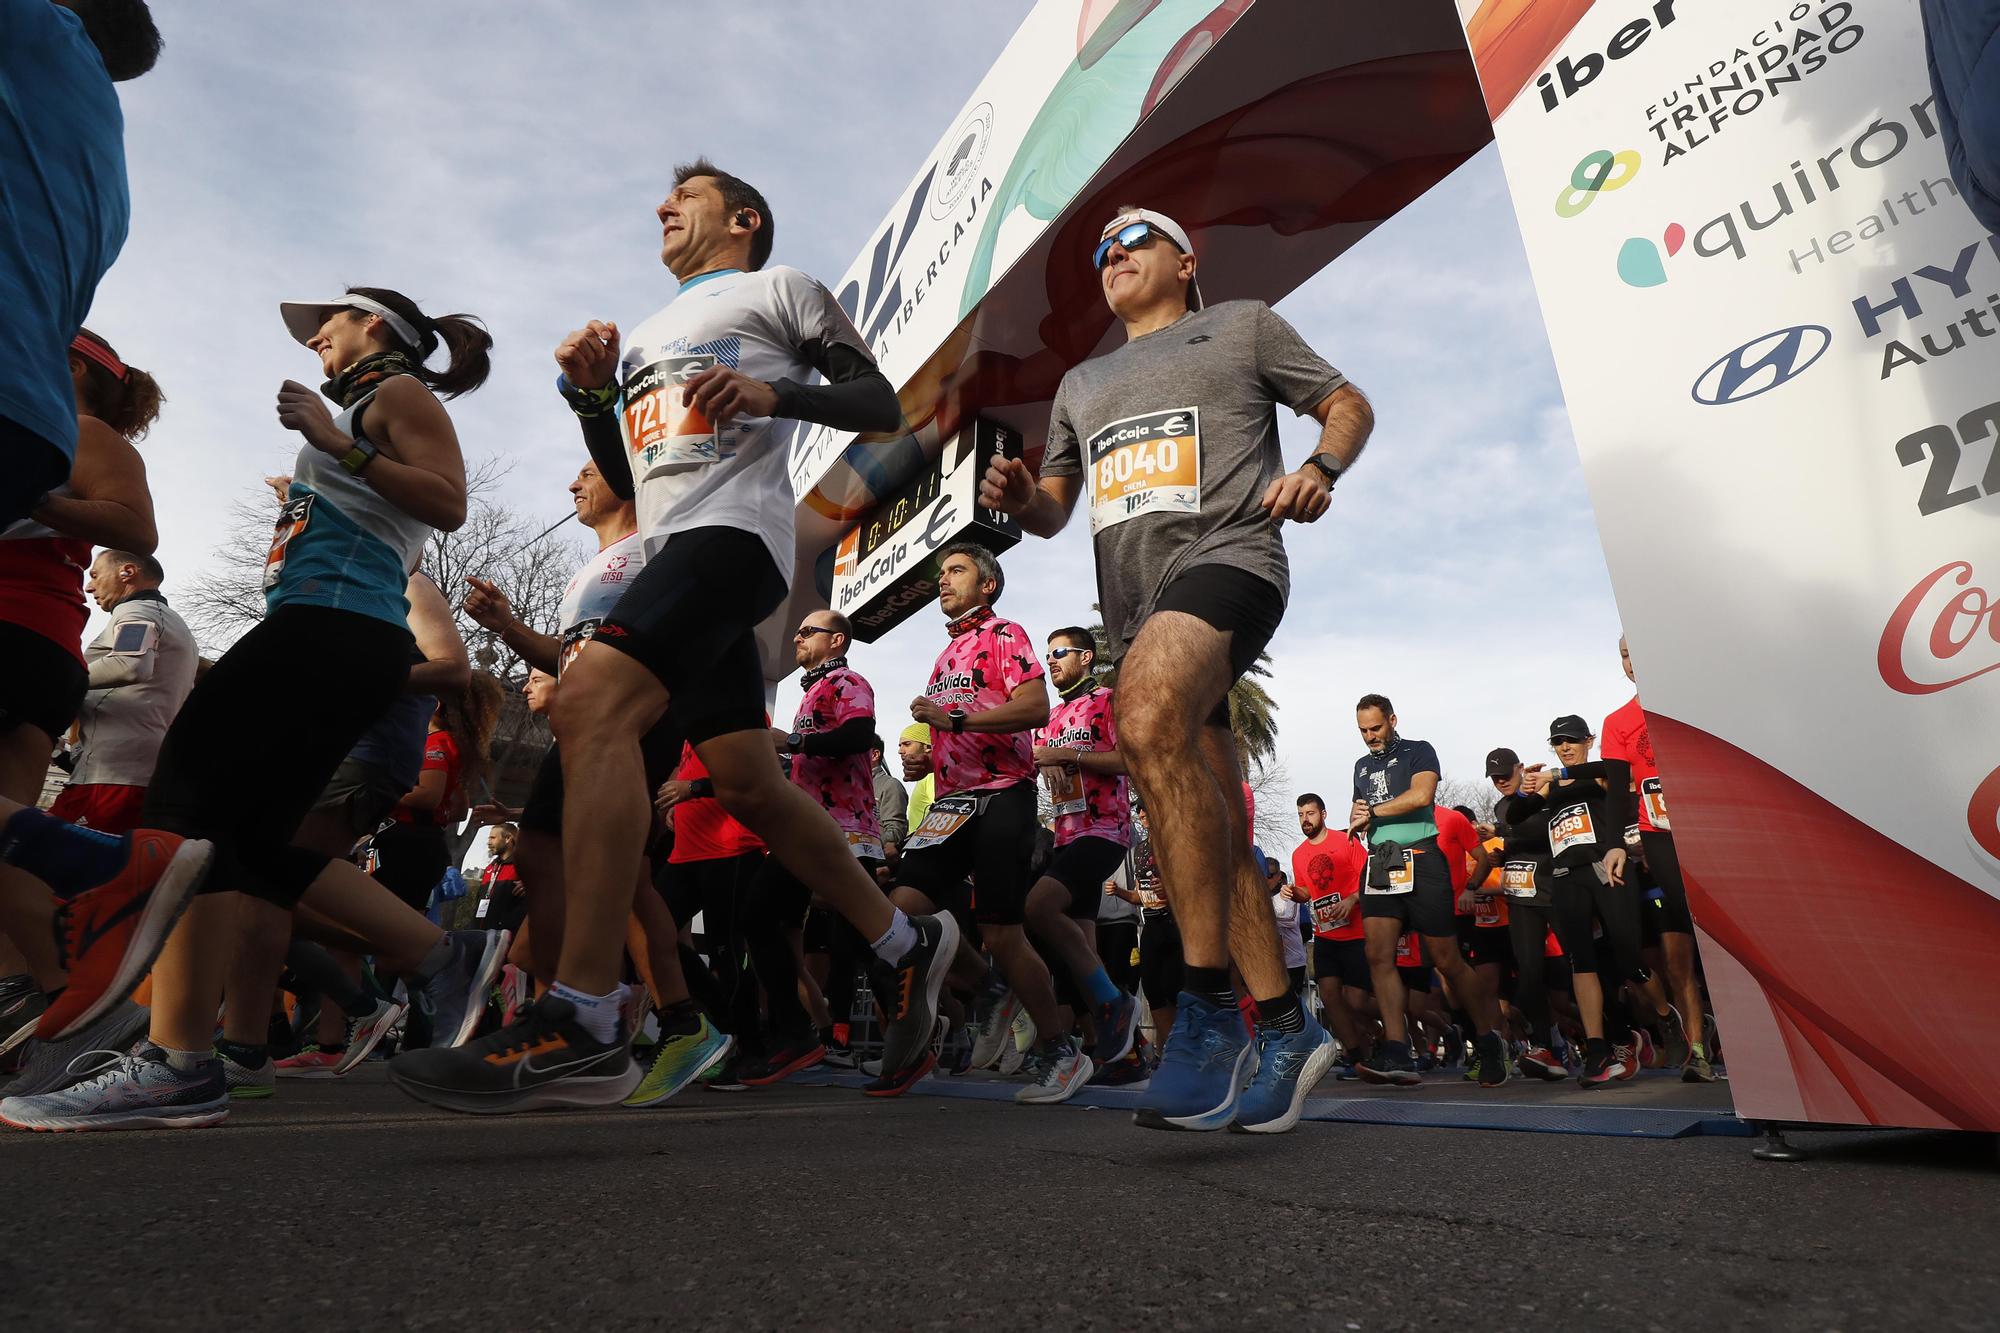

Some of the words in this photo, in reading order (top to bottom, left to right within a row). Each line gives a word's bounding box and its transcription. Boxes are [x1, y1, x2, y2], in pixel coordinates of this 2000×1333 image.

[1646, 0, 1826, 120] FUNDACIÓ
[1648, 2, 1853, 142] TRINIDAD
[1662, 24, 1864, 167] ALFONSO
[896, 176, 993, 336] IBERCAJA
[1852, 233, 2000, 338] HY
[1098, 425, 1150, 452] iberCaja
[1100, 439, 1179, 490] 8040
[839, 543, 908, 610] iberCaja
[857, 580, 935, 627] iberCaja
[1878, 560, 2000, 695] Co
[1554, 815, 1583, 839] 8359
[1505, 870, 1528, 884] 7650
